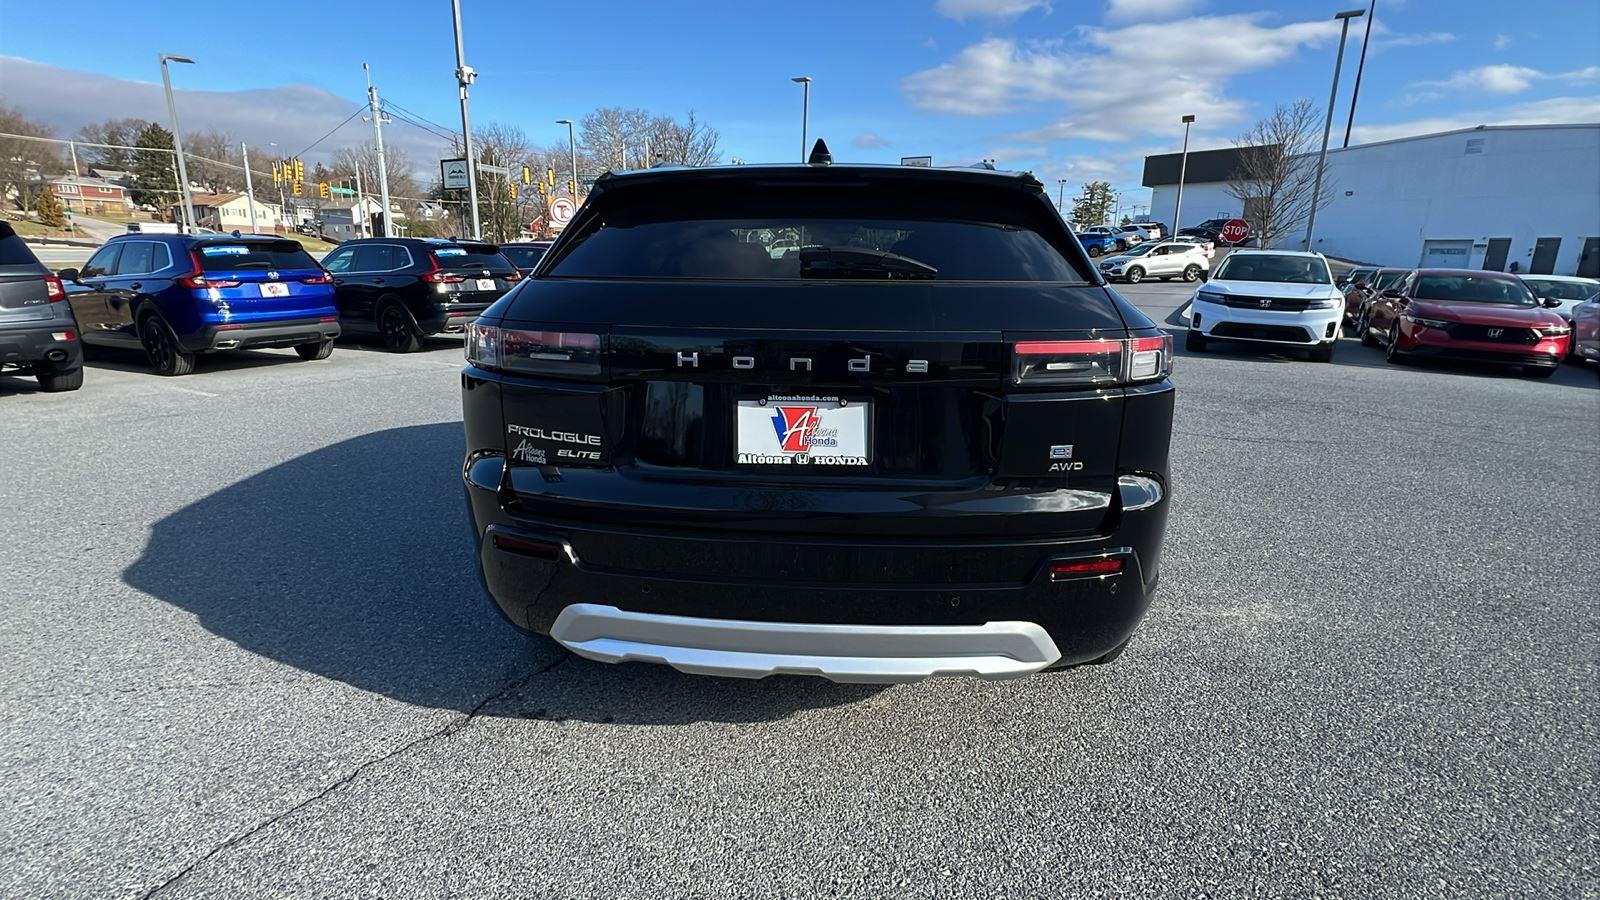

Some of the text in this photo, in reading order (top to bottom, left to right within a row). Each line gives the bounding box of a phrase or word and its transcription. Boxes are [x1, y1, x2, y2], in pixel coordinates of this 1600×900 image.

[1224, 225, 1248, 236] STOP
[677, 351, 928, 373] Honda
[767, 394, 839, 402] altoonahonda.com
[507, 423, 602, 446] PROLOGUE
[781, 410, 837, 447] Altoona
[803, 436, 837, 447] Honda
[526, 453, 547, 465] Honda
[557, 448, 602, 460] ELITE
[737, 453, 869, 466] Altoona HONDA
[1048, 461, 1084, 472] AWD
